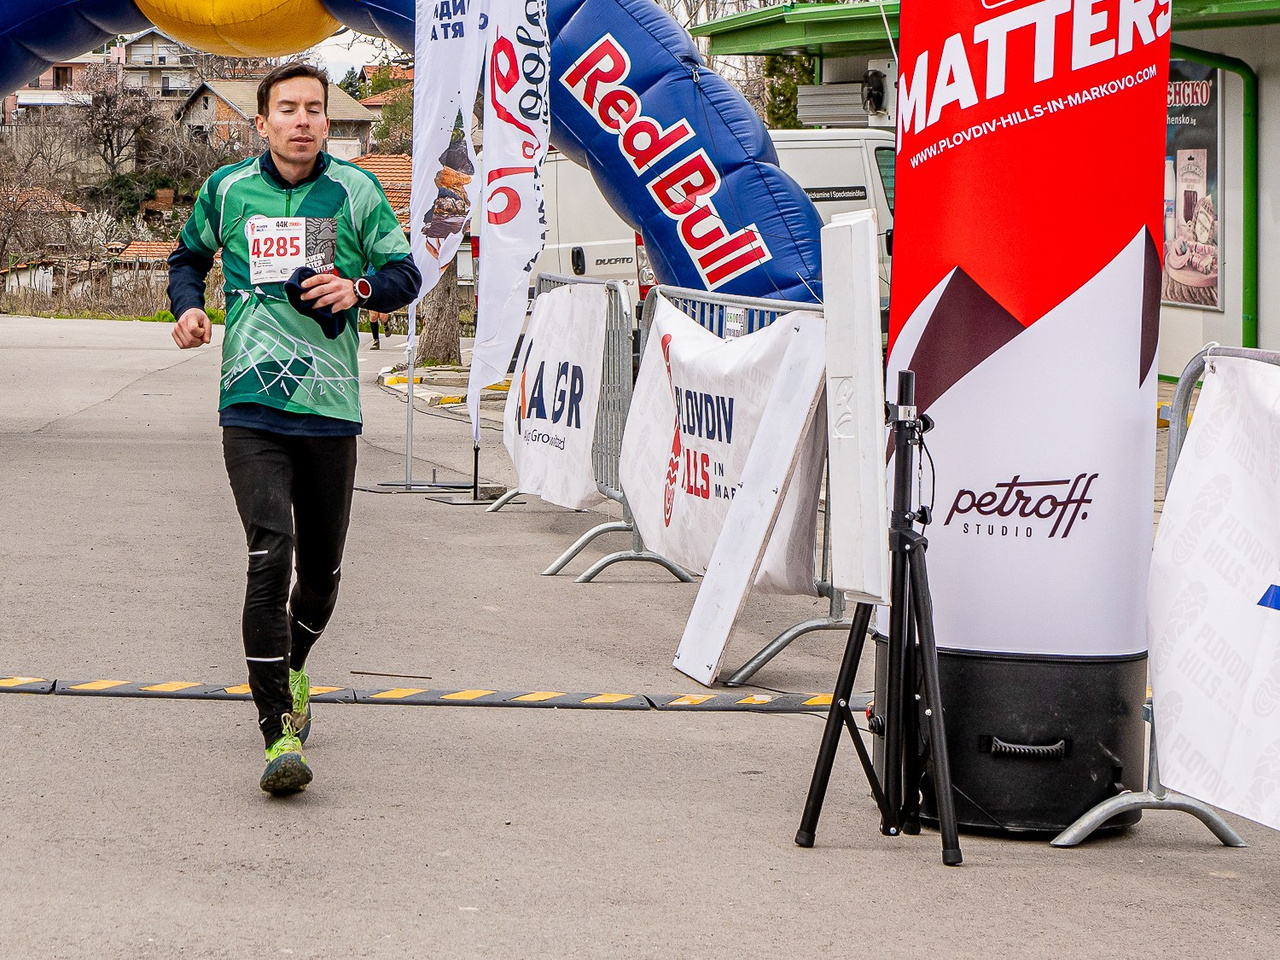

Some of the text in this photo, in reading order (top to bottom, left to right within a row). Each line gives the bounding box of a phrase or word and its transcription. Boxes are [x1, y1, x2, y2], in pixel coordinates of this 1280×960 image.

[910, 64, 1157, 169] WWW.PLOVDIV-HILLS-IN-MARKOVO.COM
[559, 33, 774, 292] Red Bull
[251, 236, 301, 259] 4285
[595, 257, 634, 266] DUCATO
[675, 386, 735, 445] PLOVDIV
[714, 461, 725, 477] IN
[963, 523, 1033, 538] STUDIO
